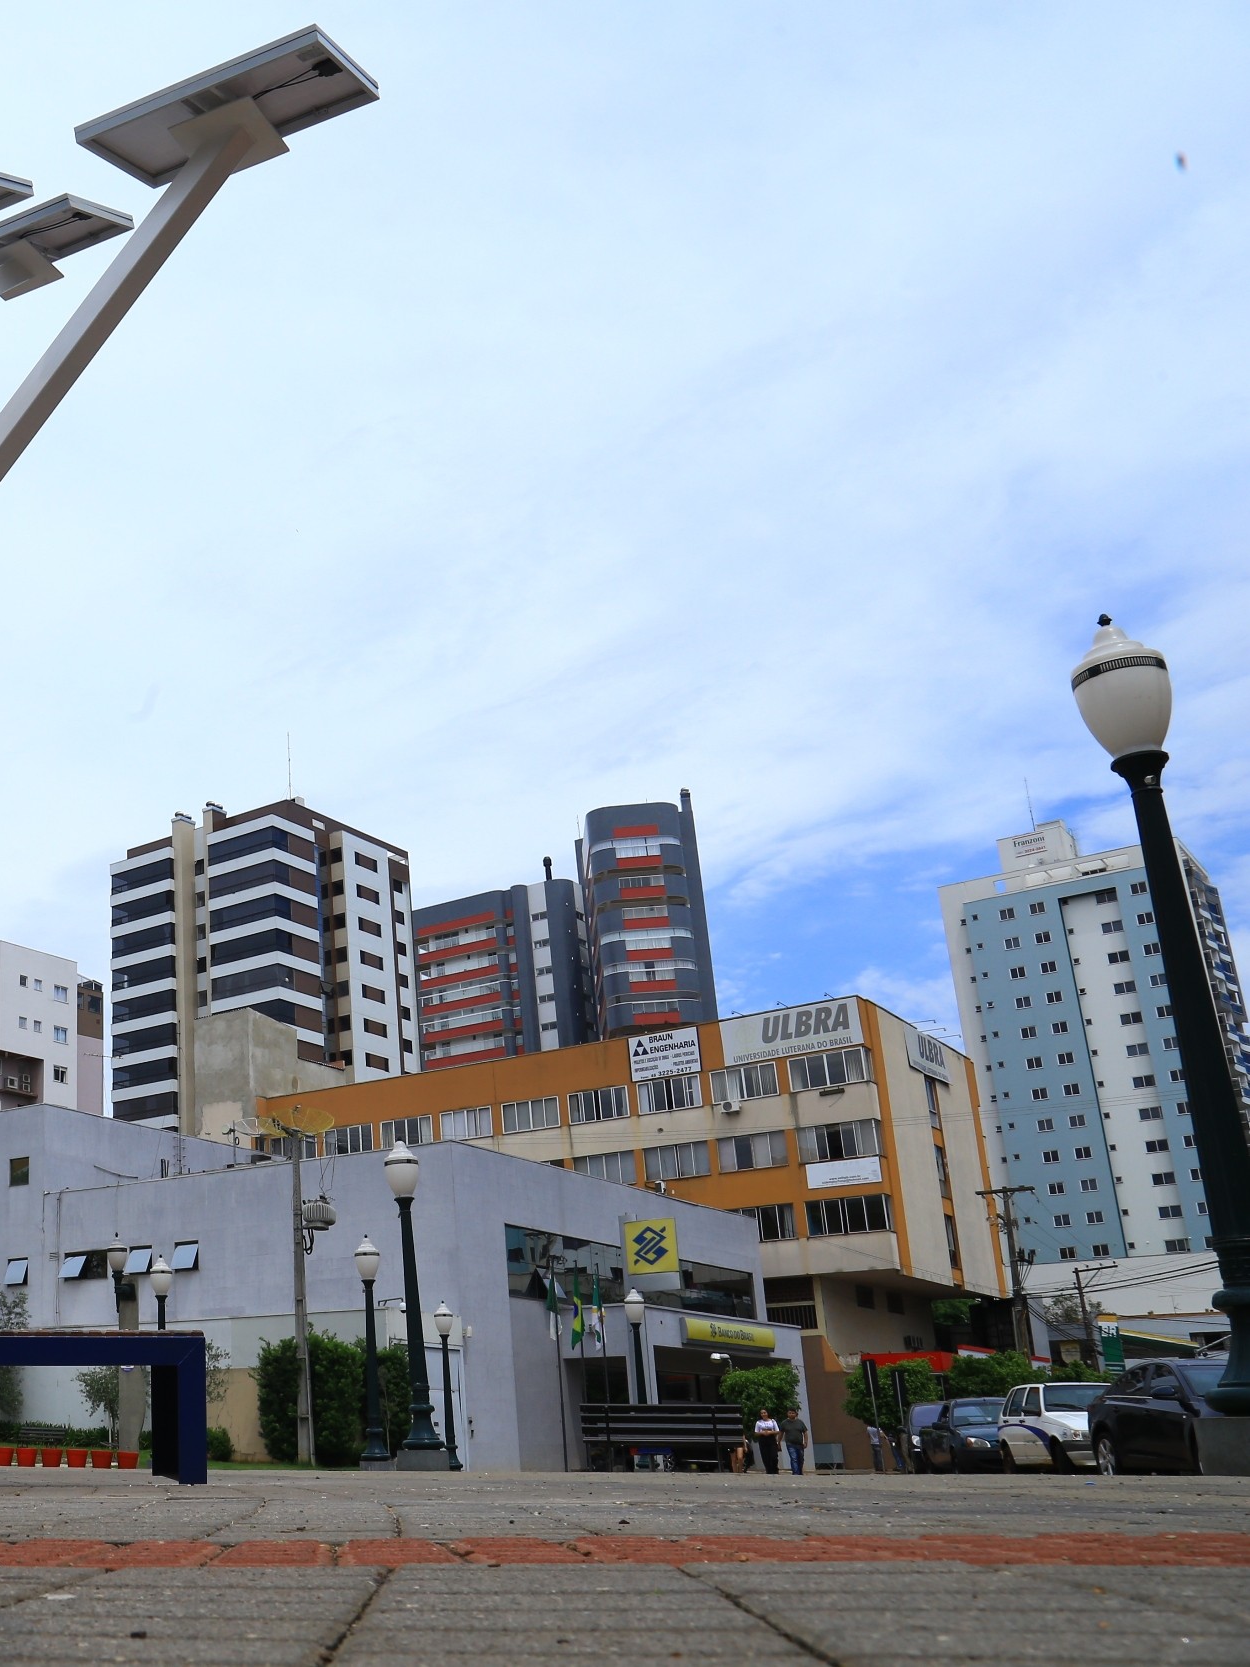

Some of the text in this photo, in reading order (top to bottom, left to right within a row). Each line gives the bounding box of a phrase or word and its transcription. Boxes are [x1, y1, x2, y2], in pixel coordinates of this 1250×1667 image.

[761, 1003, 850, 1044] ULBRA
[648, 1033, 673, 1044] BRAUN
[650, 1040, 696, 1054] ENGENHARIA
[733, 1036, 853, 1063] UNIVERSIDADE LUTERANA DO BRASIL
[918, 1034, 946, 1069] ULBRA
